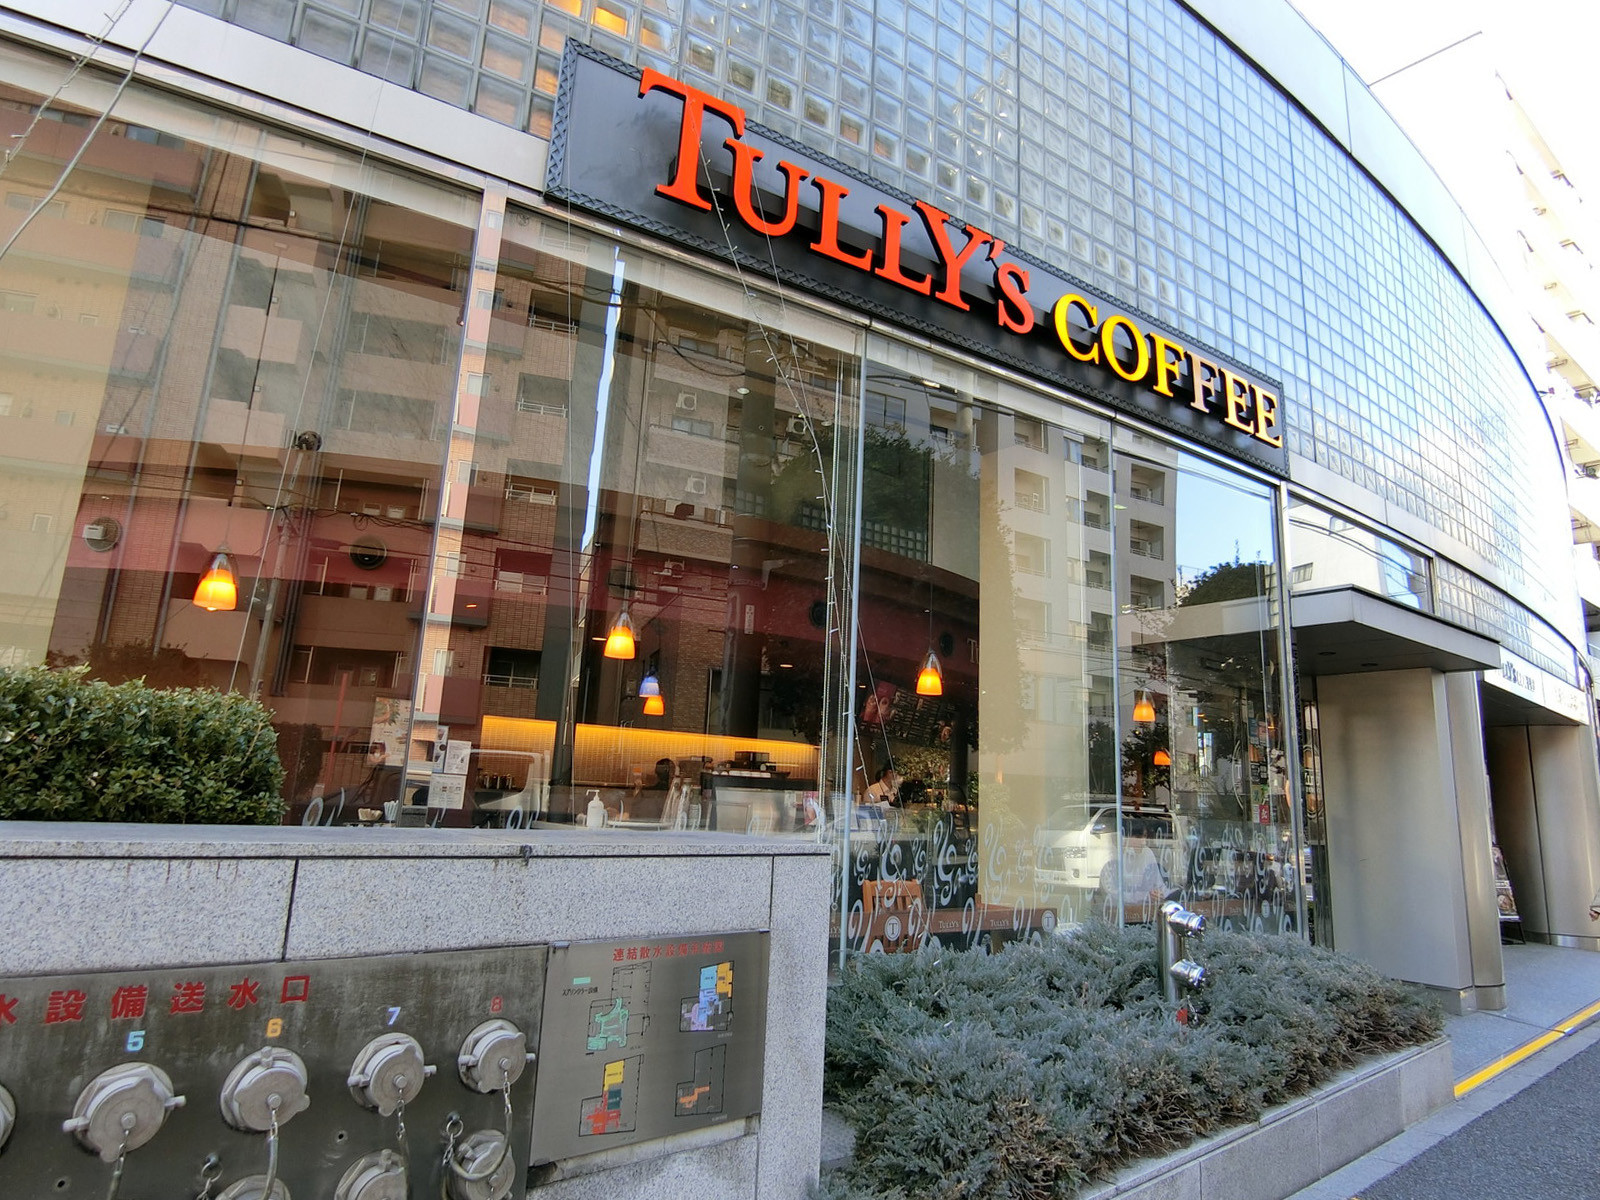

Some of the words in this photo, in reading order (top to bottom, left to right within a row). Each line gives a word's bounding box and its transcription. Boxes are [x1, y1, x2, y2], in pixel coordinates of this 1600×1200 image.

[639, 66, 1035, 334] TULLY'S
[1053, 292, 1284, 449] COFFEE
[490, 996, 502, 1012] 8
[387, 1006, 402, 1025] 7
[266, 1017, 283, 1037] 6
[126, 1030, 145, 1052] 5
